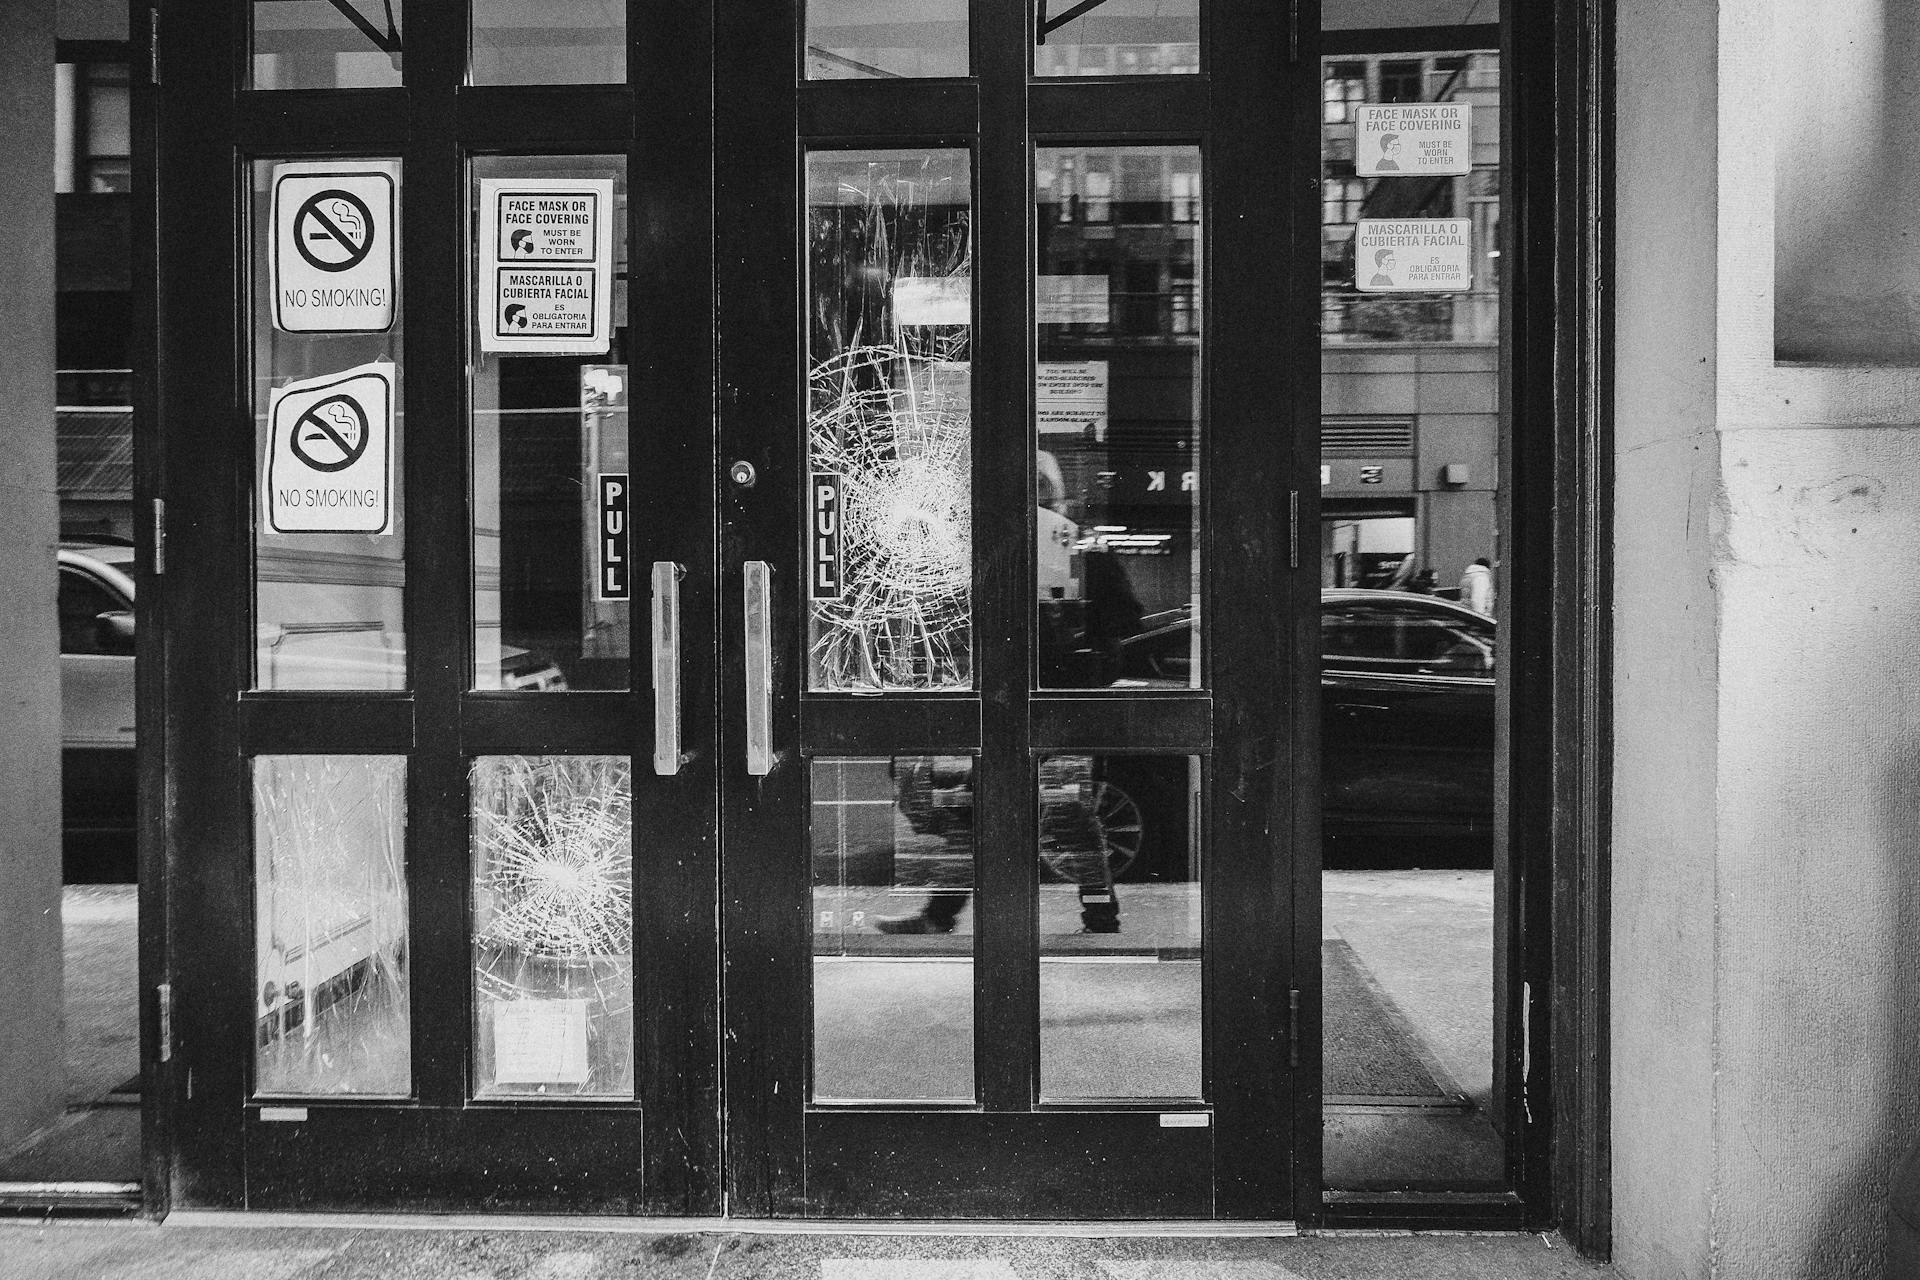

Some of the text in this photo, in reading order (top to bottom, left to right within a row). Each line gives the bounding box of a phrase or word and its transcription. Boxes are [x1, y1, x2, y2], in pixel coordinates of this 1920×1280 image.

[1369, 107, 1458, 120] FACE MASK OR
[1367, 119, 1460, 131] FACE COVERING
[1424, 149, 1447, 157] WORN
[1418, 157, 1427, 165] TO
[509, 201, 585, 211] FACE MASK OR
[506, 214, 588, 224] FACE COVERING
[1369, 224, 1457, 235] MASCARILLA O
[1362, 235, 1464, 246] CUBIERTA FACIAL
[1410, 264, 1460, 272] OBLIGATORIA
[510, 275, 582, 286] MASCARILLA O
[1409, 272, 1461, 280] PARA ENTRAR
[286, 288, 385, 307] NO SMOKING!
[504, 288, 588, 298] CUBIERTA FACIAL
[280, 489, 378, 507] NO SMOKING!
[606, 482, 622, 591] PULL
[818, 486, 835, 587] PULL
